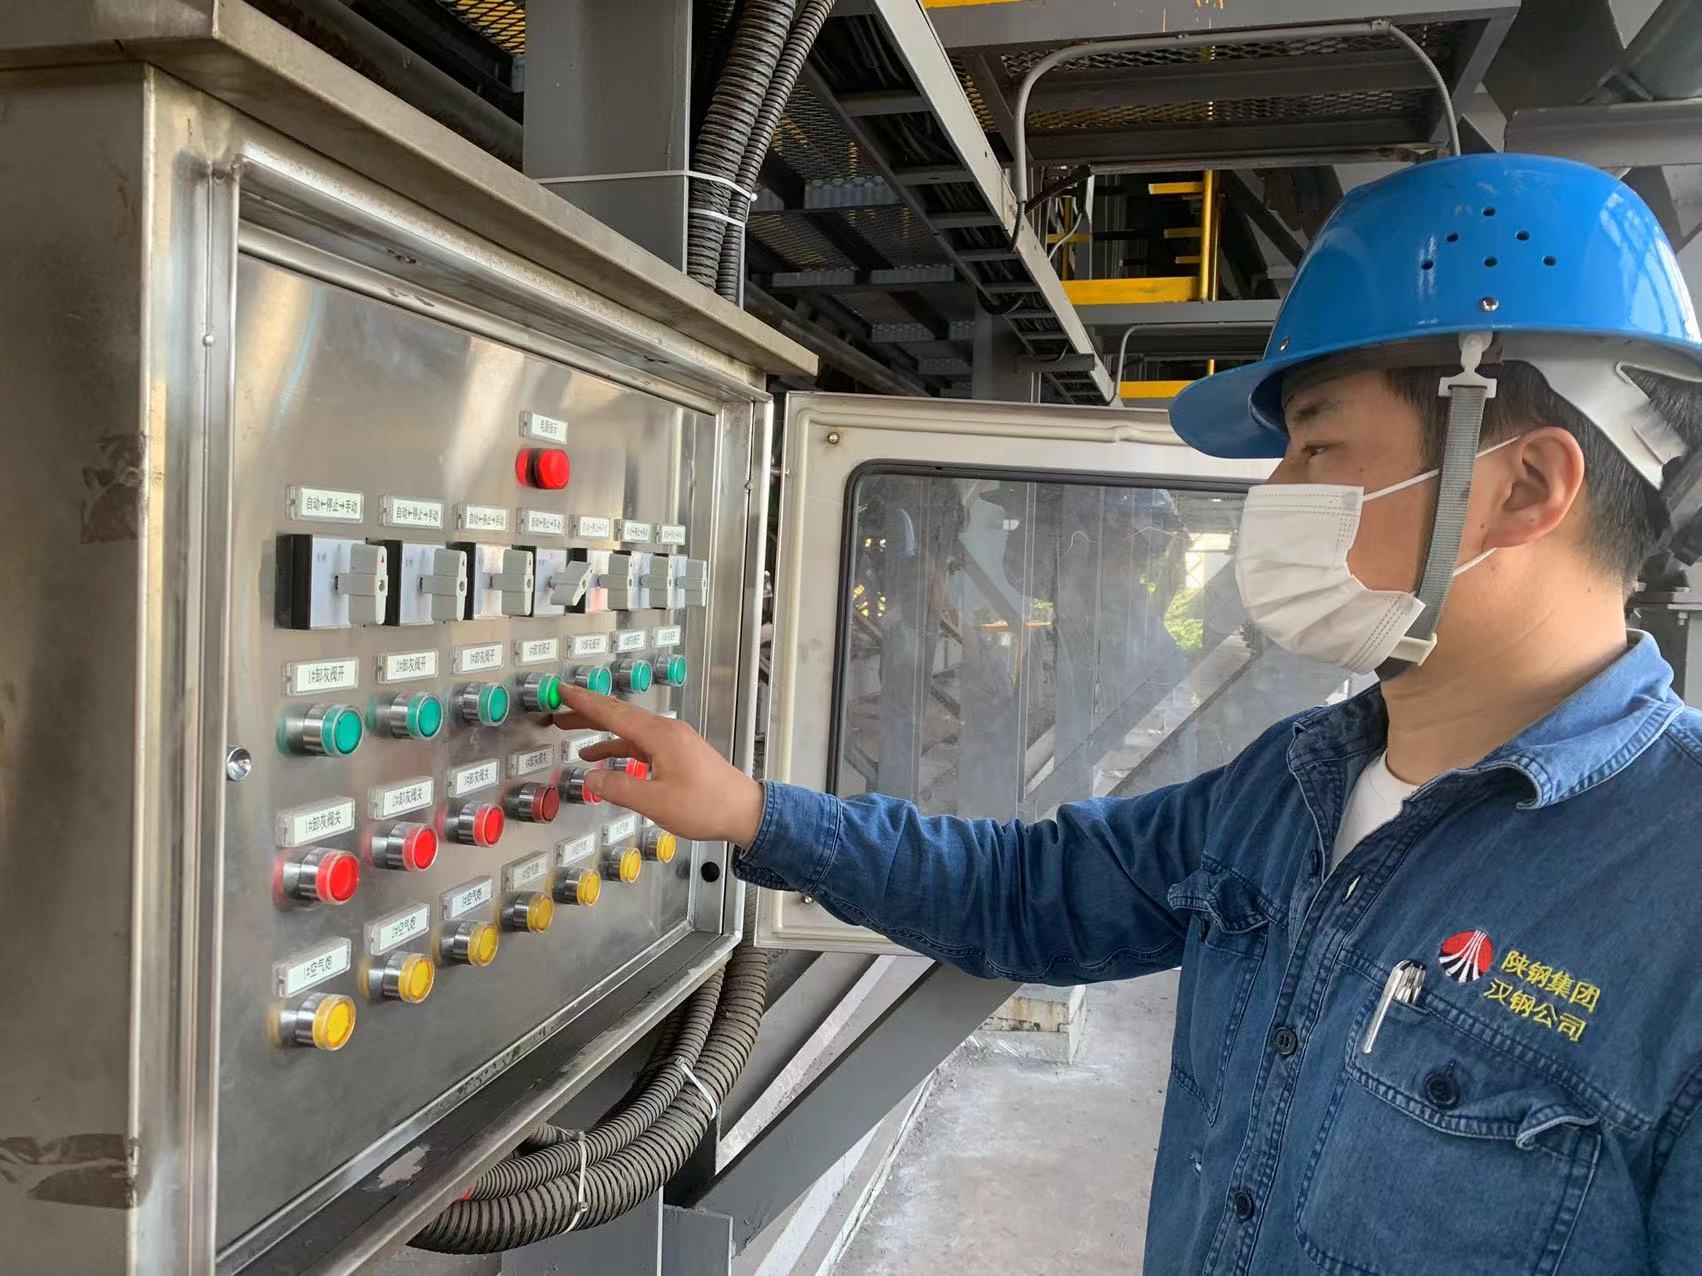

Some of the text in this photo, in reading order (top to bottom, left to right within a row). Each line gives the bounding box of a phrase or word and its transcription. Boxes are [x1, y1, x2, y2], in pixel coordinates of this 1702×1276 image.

[308, 665, 345, 684] 1#卸灰阀开
[305, 810, 342, 834] 1#卸灰阀关
[1500, 949, 1601, 1013] 陕钢集团
[1482, 977, 1587, 1042] 汉钢公司
